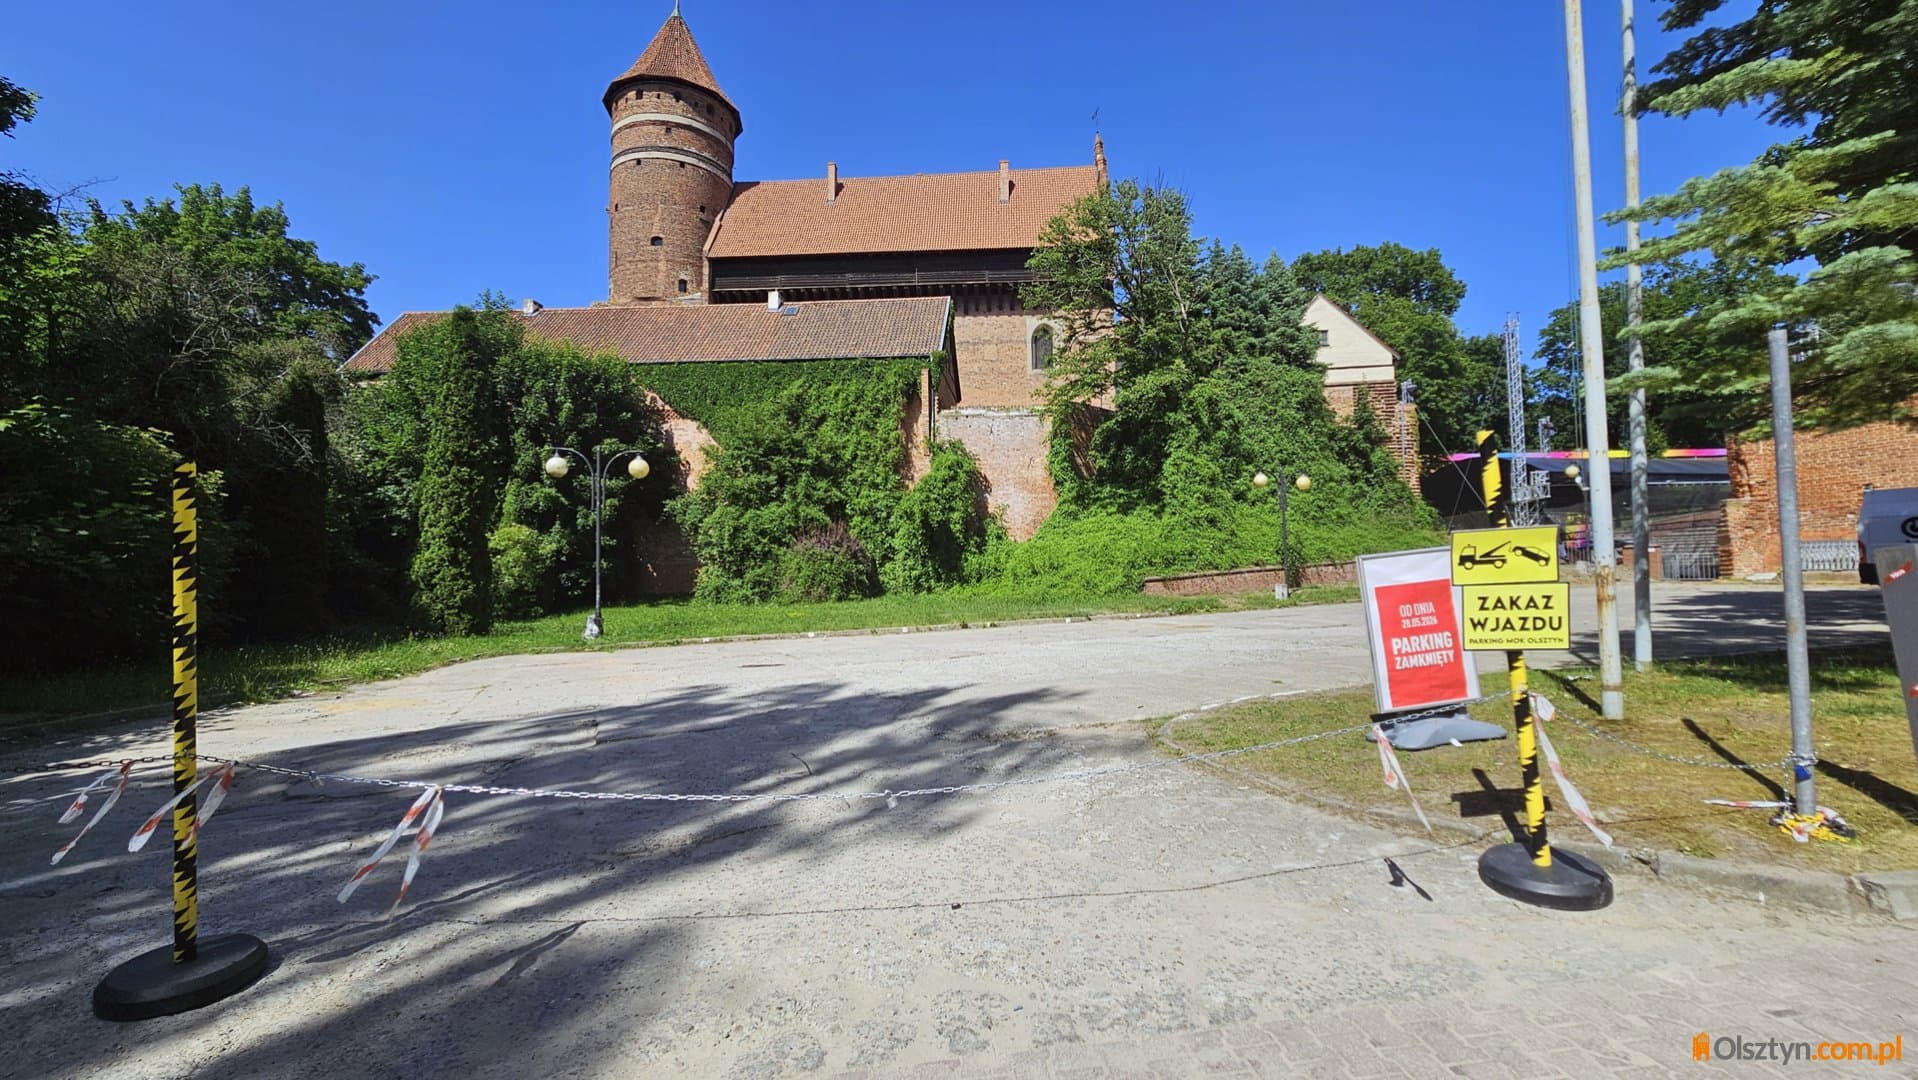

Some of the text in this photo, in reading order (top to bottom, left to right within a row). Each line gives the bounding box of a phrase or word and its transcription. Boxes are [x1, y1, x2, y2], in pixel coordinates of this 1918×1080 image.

[1399, 601, 1436, 618] OD DNIA
[1477, 594, 1554, 611] ZAKAZ
[1469, 615, 1562, 632] WJAZDU
[1391, 631, 1454, 655] PARKING
[1395, 649, 1455, 670] ZAMKNIĘTY
